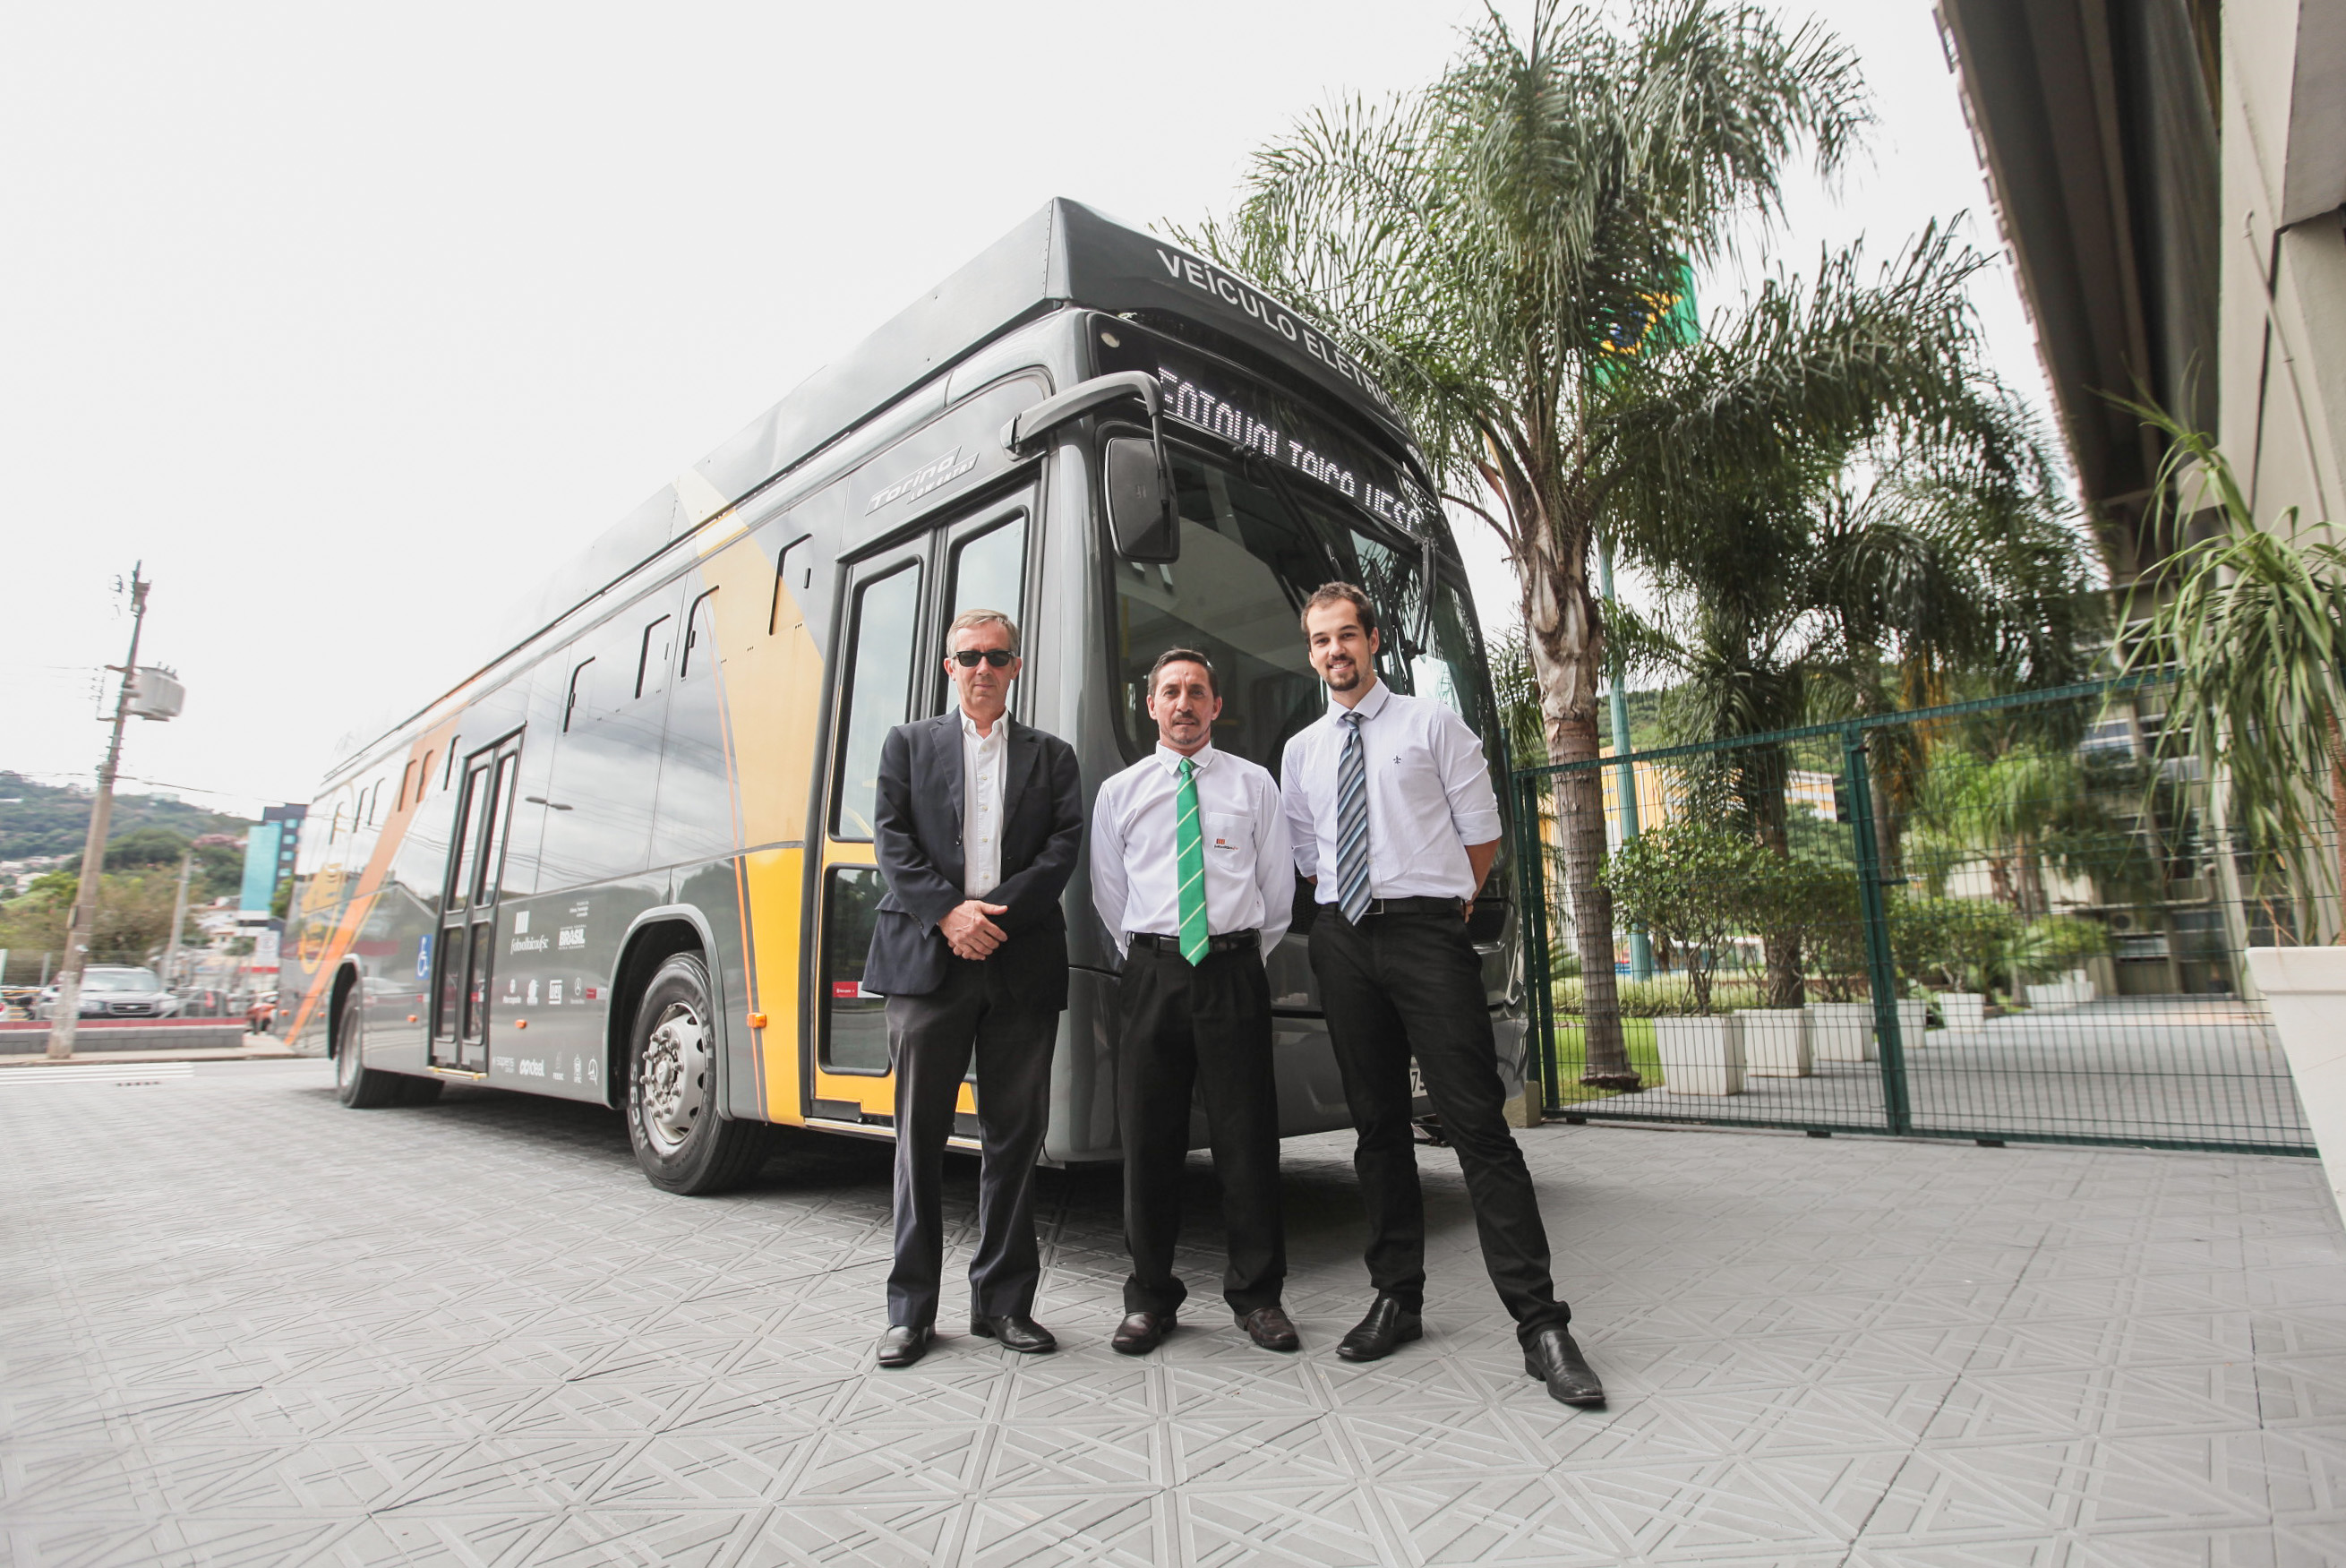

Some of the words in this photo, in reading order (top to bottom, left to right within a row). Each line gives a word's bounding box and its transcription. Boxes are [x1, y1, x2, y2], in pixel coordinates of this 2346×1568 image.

[1156, 248, 1297, 342] VEÍCULO
[910, 481, 935, 501] LOW
[559, 928, 586, 947] BRASIL
